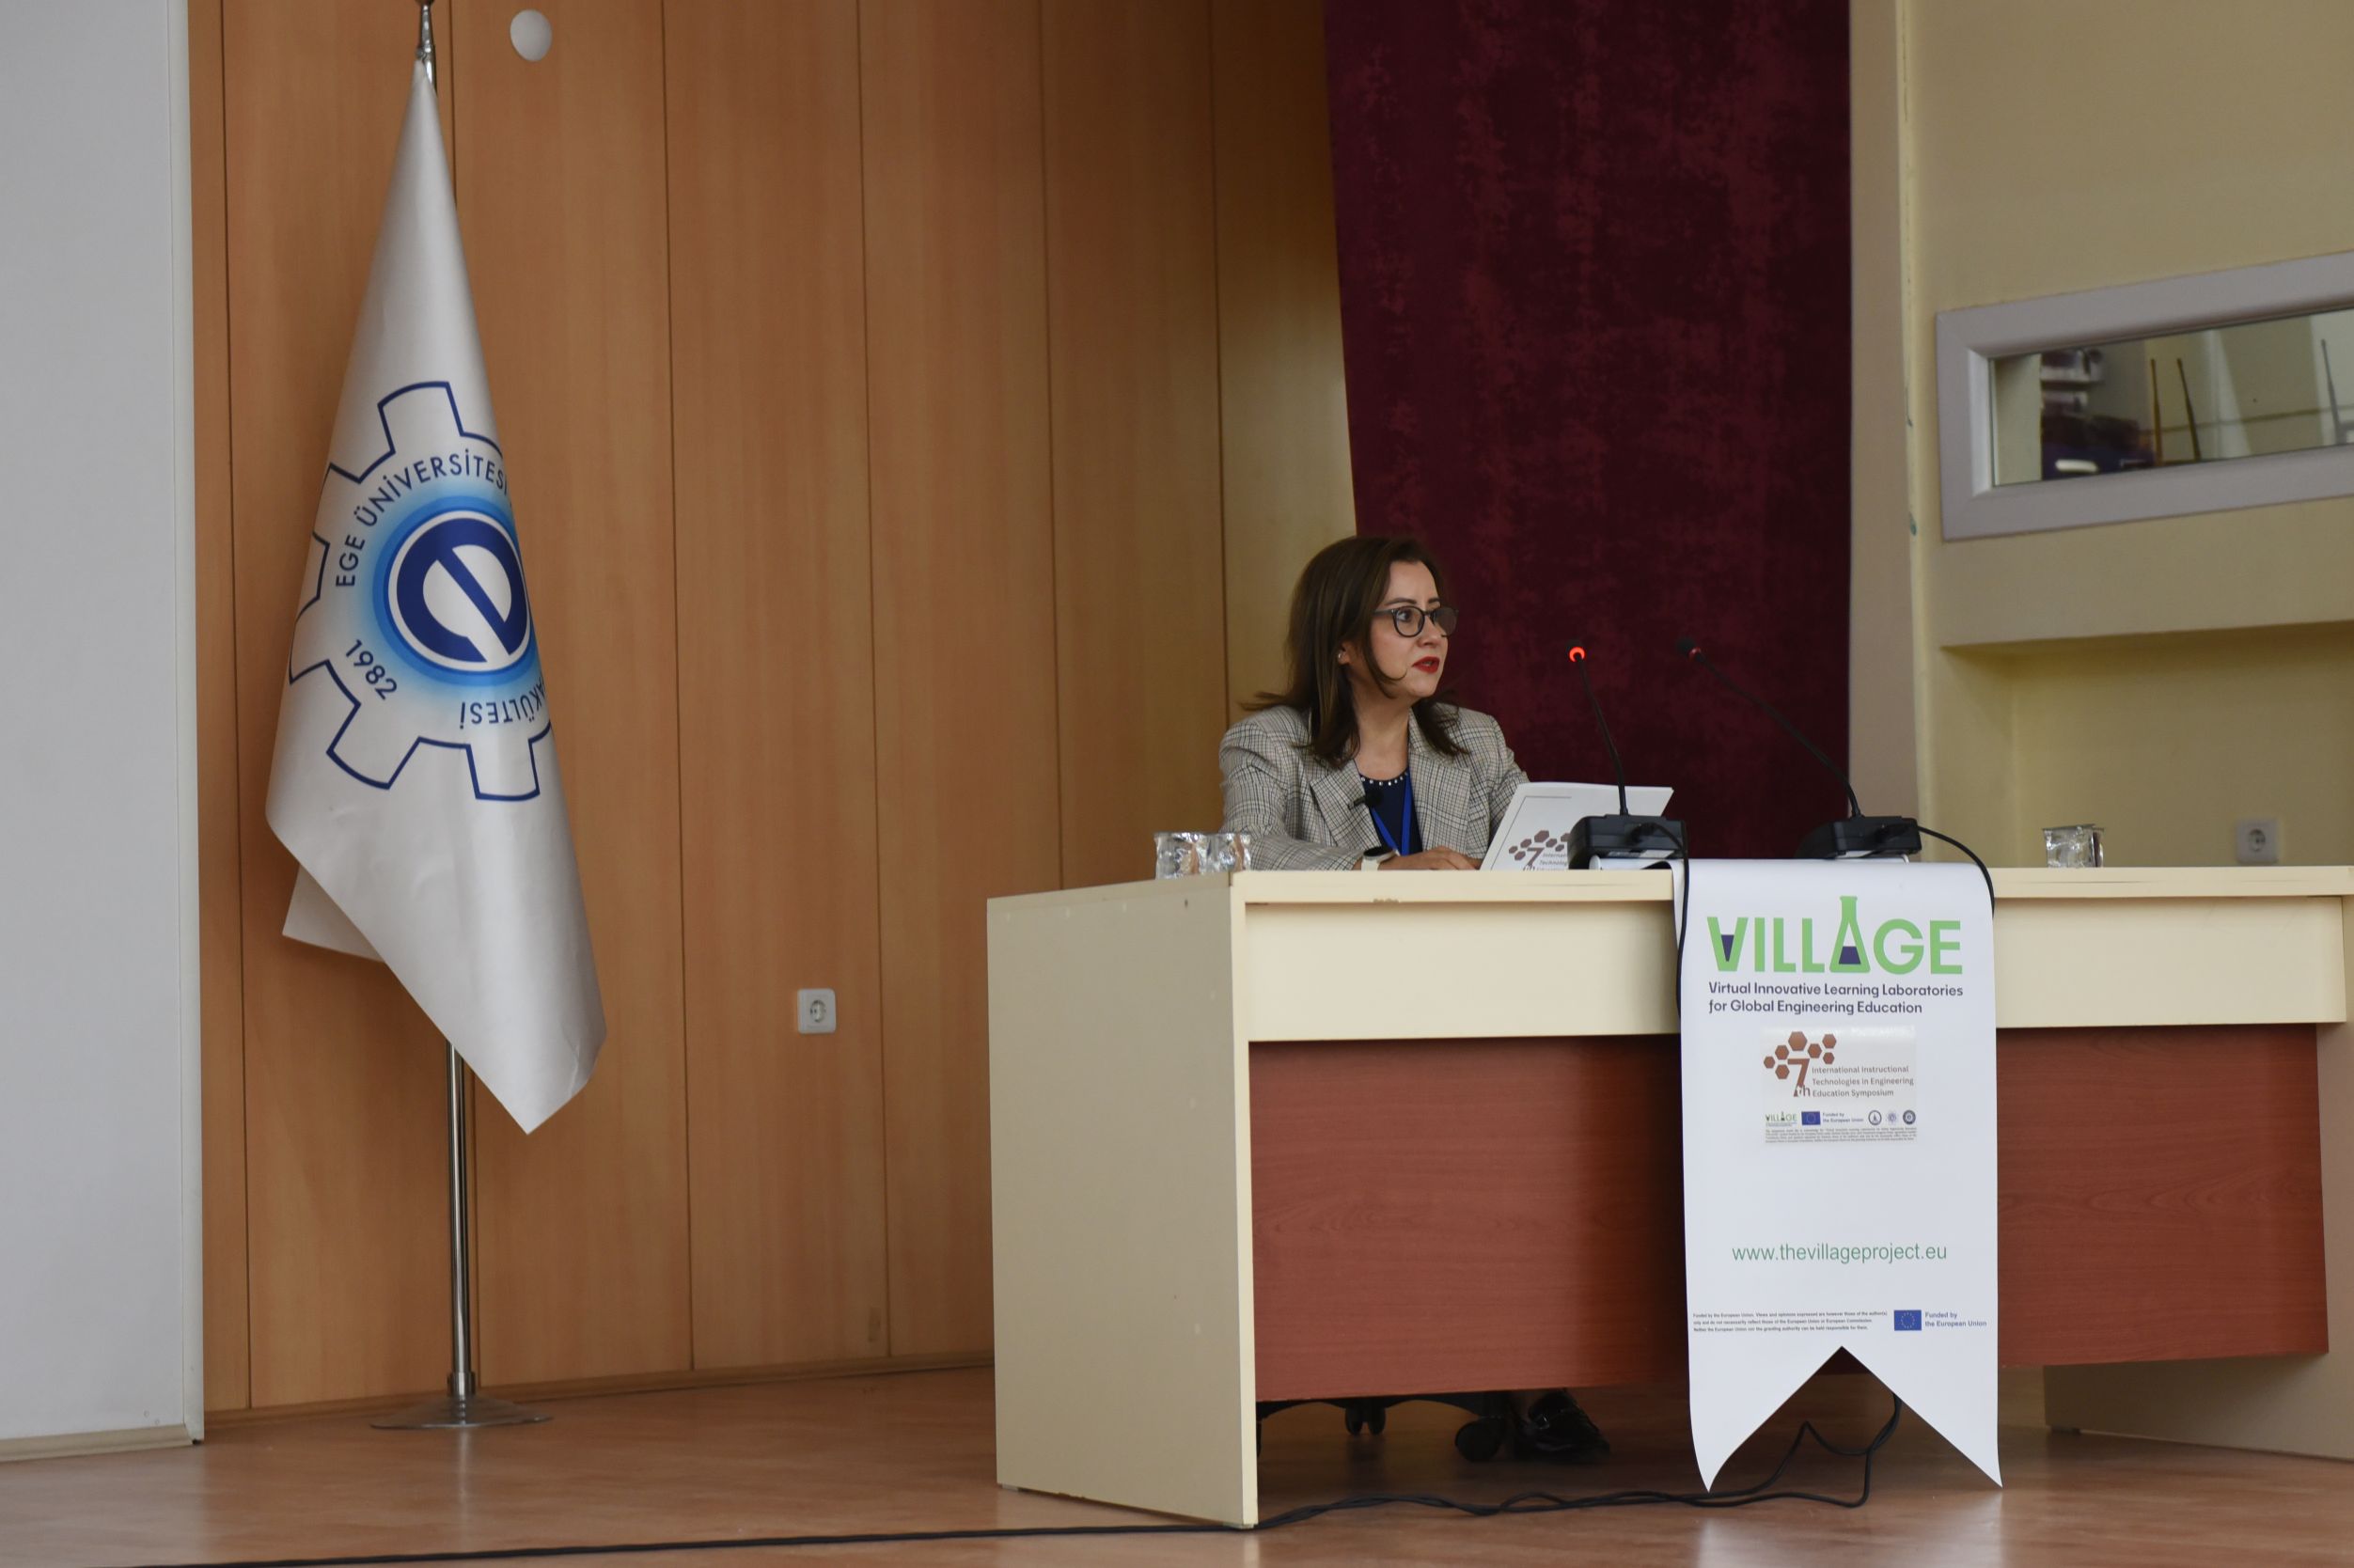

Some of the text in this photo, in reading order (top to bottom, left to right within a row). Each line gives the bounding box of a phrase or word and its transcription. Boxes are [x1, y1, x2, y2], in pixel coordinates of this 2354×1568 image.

[336, 534, 366, 588] EGE
[345, 639, 397, 700] 1982
[460, 676, 547, 729] AKÜLTESİ
[1706, 895, 1963, 975] VILLAGE
[1709, 981, 1964, 998] Virtual Innovative Learning Laboratories
[1709, 999, 1922, 1015] for Global Engineering Education
[1861, 1064, 1909, 1074] Instructional
[1813, 1078, 1860, 1087] Technologies
[1871, 1077, 1914, 1087] Engineering
[1813, 1089, 1894, 1098] Education Symposium
[1732, 1243, 1947, 1264] www.thevillageproject.eu
[1950, 1311, 1957, 1320] by
[1936, 1320, 1967, 1328] European
